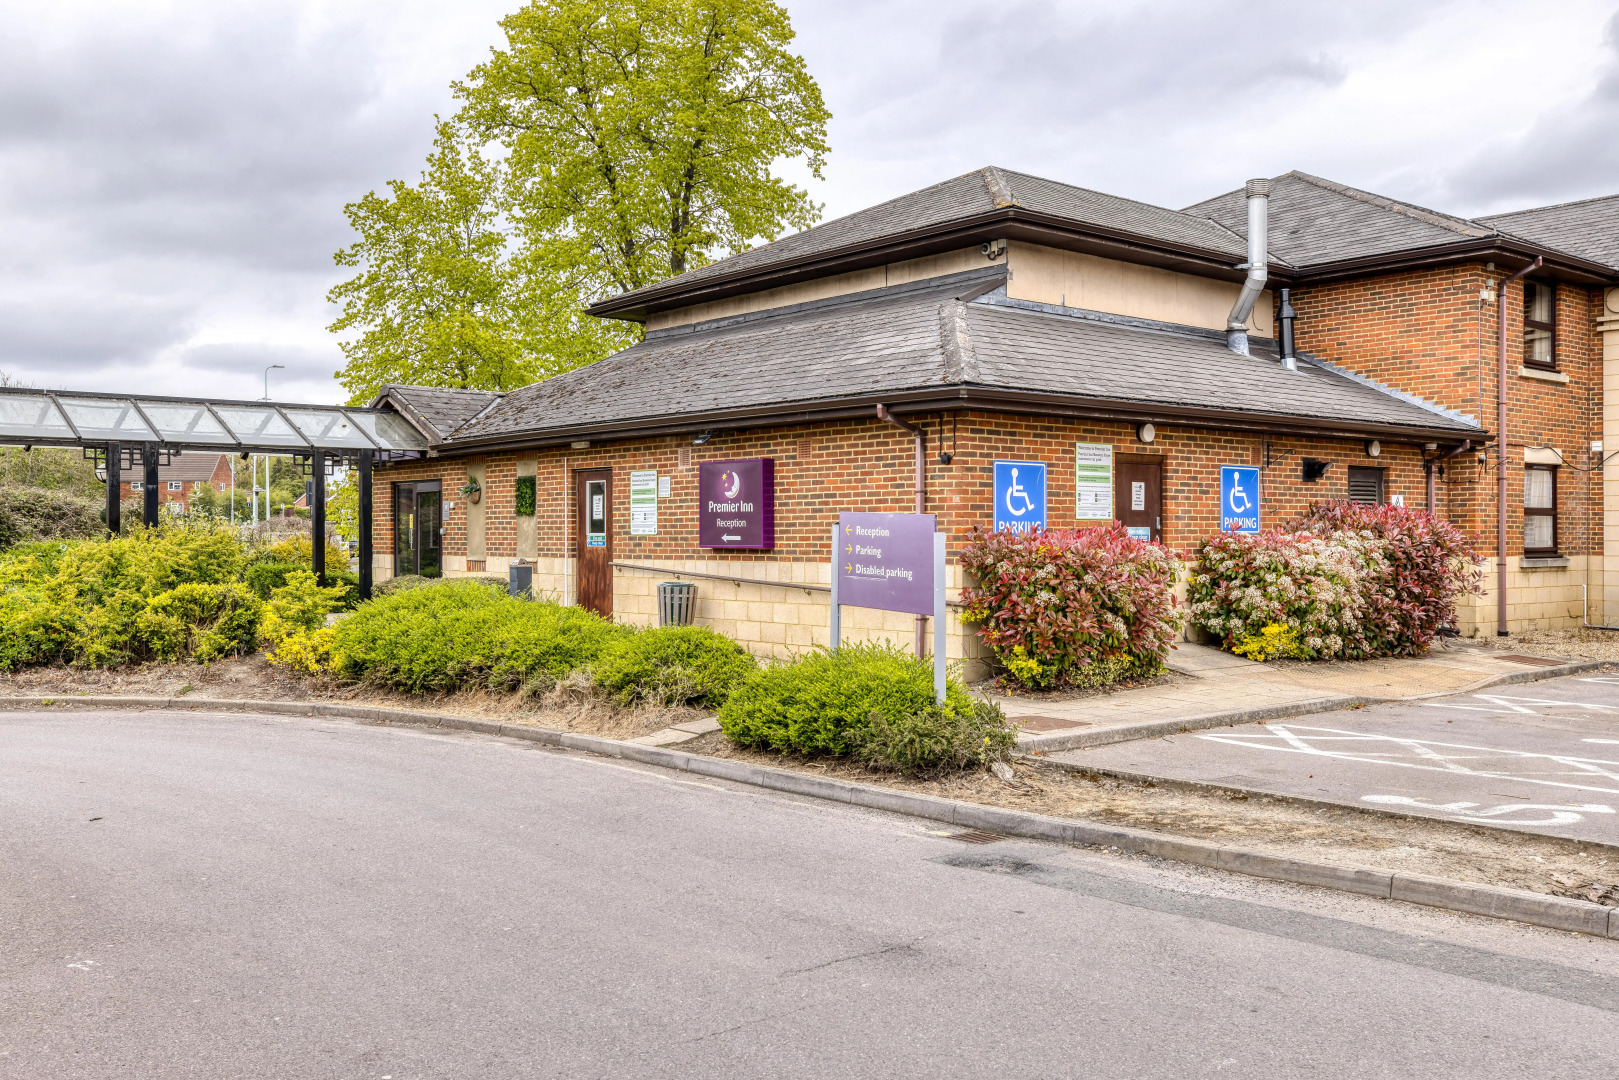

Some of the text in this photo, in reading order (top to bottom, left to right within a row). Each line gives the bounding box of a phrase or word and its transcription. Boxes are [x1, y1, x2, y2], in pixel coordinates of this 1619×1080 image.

[708, 500, 754, 513] Premier Inn
[716, 518, 747, 529] Reception
[856, 525, 890, 539] Reception
[855, 544, 882, 558] Parking
[855, 563, 913, 581] Disabled parking
